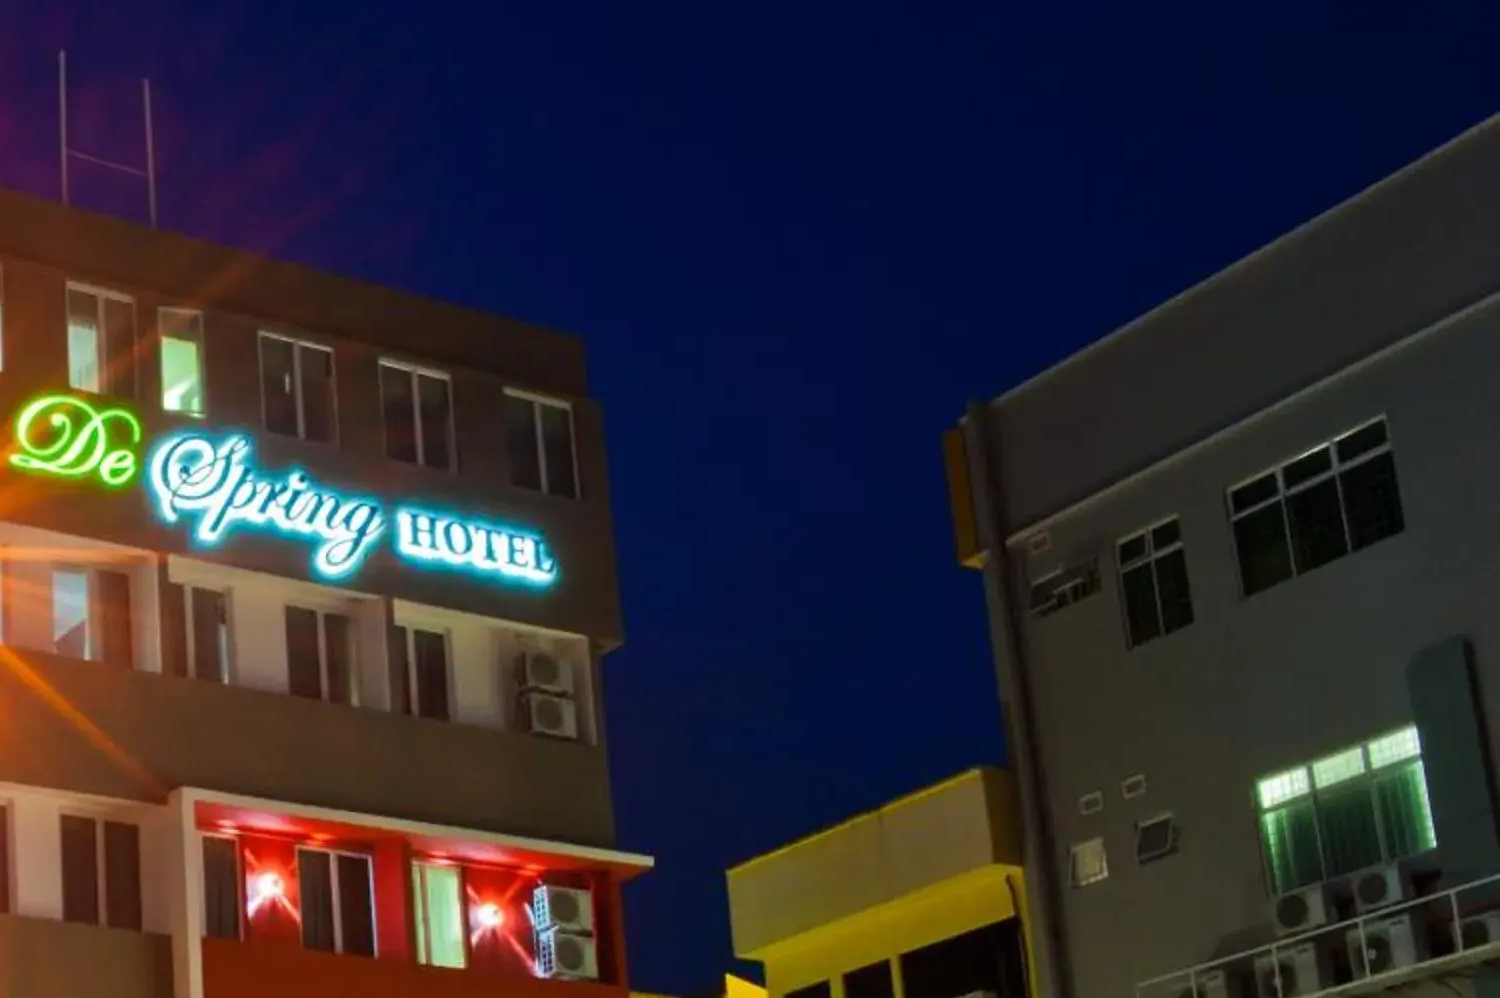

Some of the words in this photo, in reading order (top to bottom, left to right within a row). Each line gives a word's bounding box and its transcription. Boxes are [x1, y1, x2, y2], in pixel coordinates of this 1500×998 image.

[8, 394, 141, 486] De
[155, 433, 387, 570] Spring
[402, 510, 556, 577] HOTEL
